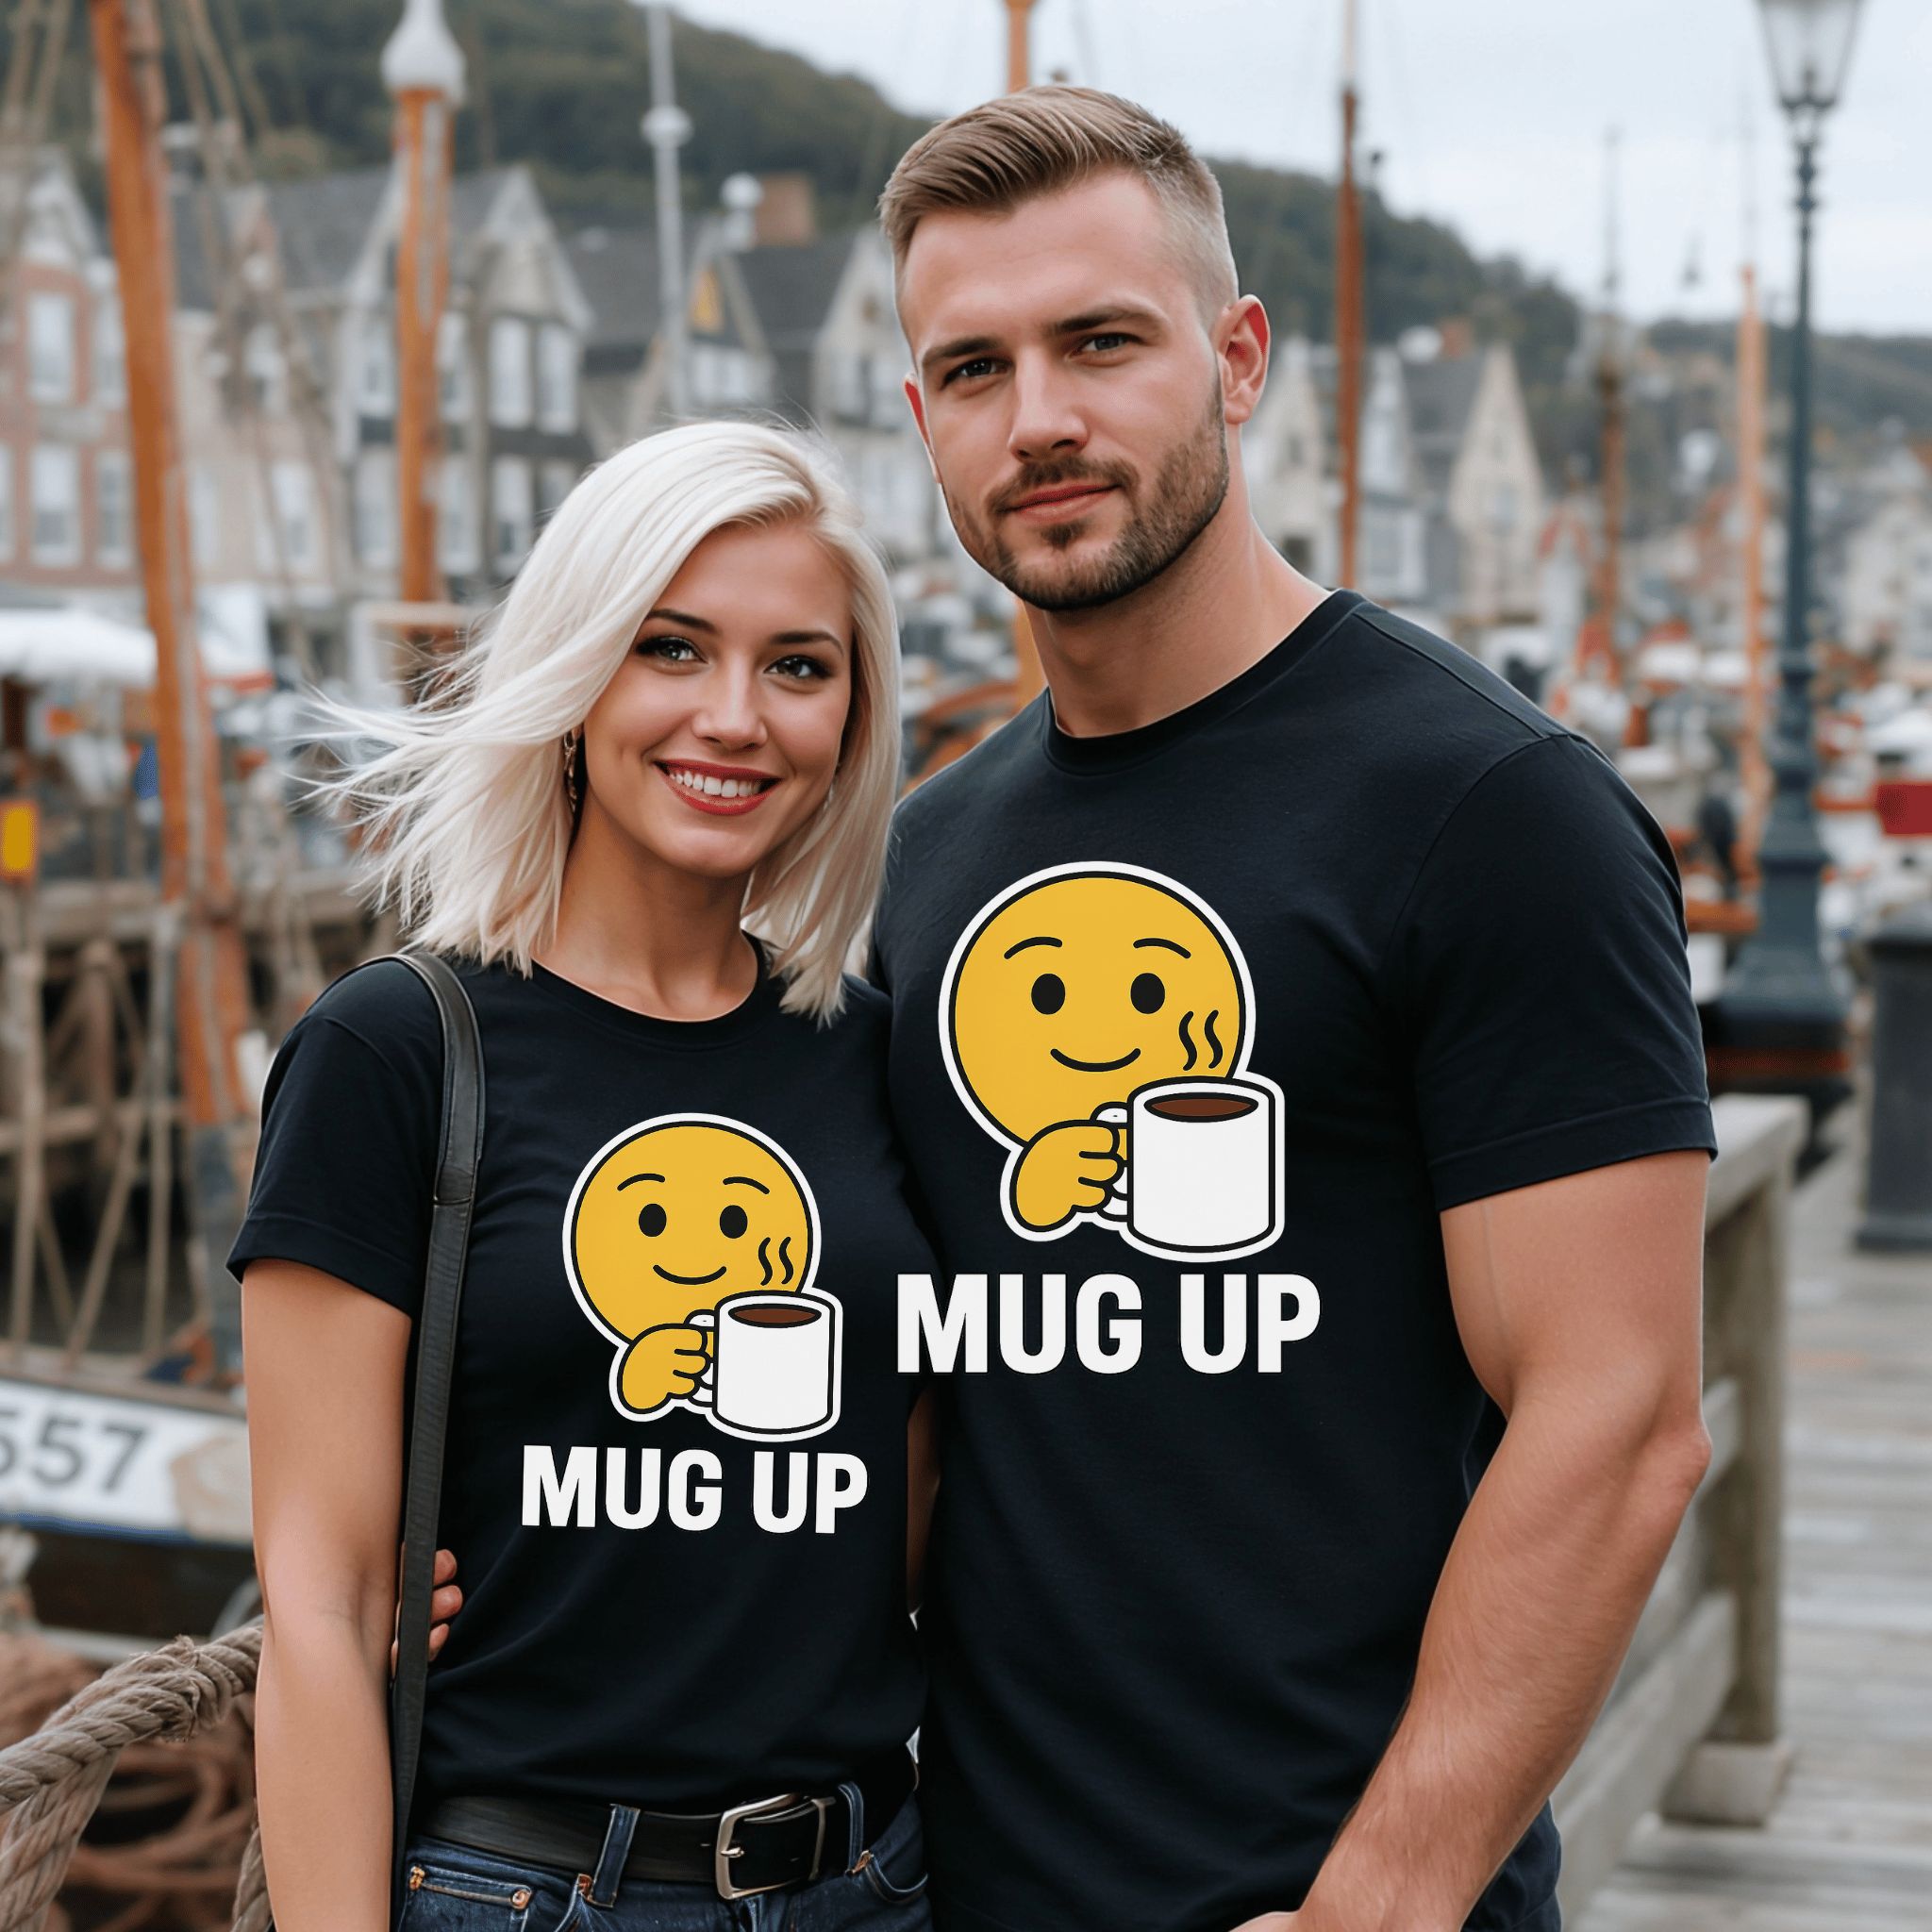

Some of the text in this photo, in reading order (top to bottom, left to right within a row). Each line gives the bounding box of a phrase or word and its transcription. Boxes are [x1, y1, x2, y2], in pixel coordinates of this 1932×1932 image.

[897, 1274, 1321, 1374] MUG UP
[522, 1444, 868, 1534] MUG UP
